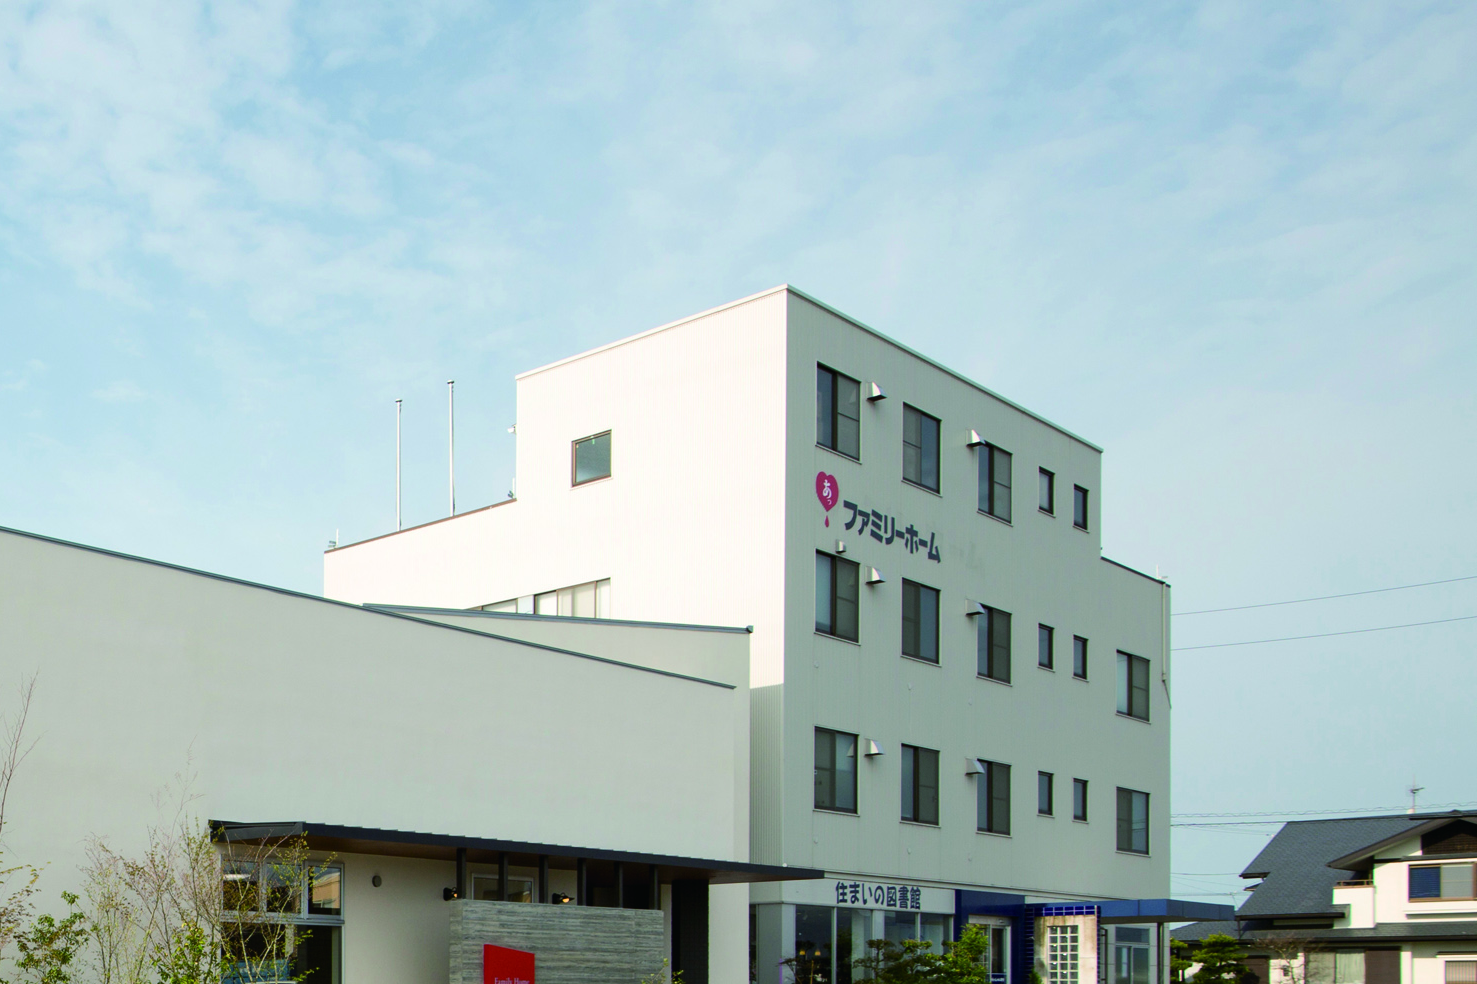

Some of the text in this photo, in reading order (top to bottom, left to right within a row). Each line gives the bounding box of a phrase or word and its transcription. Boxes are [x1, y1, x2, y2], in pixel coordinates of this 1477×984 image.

[843, 500, 941, 563] ファミリーホーム
[836, 881, 921, 910] 住まいの図書館
